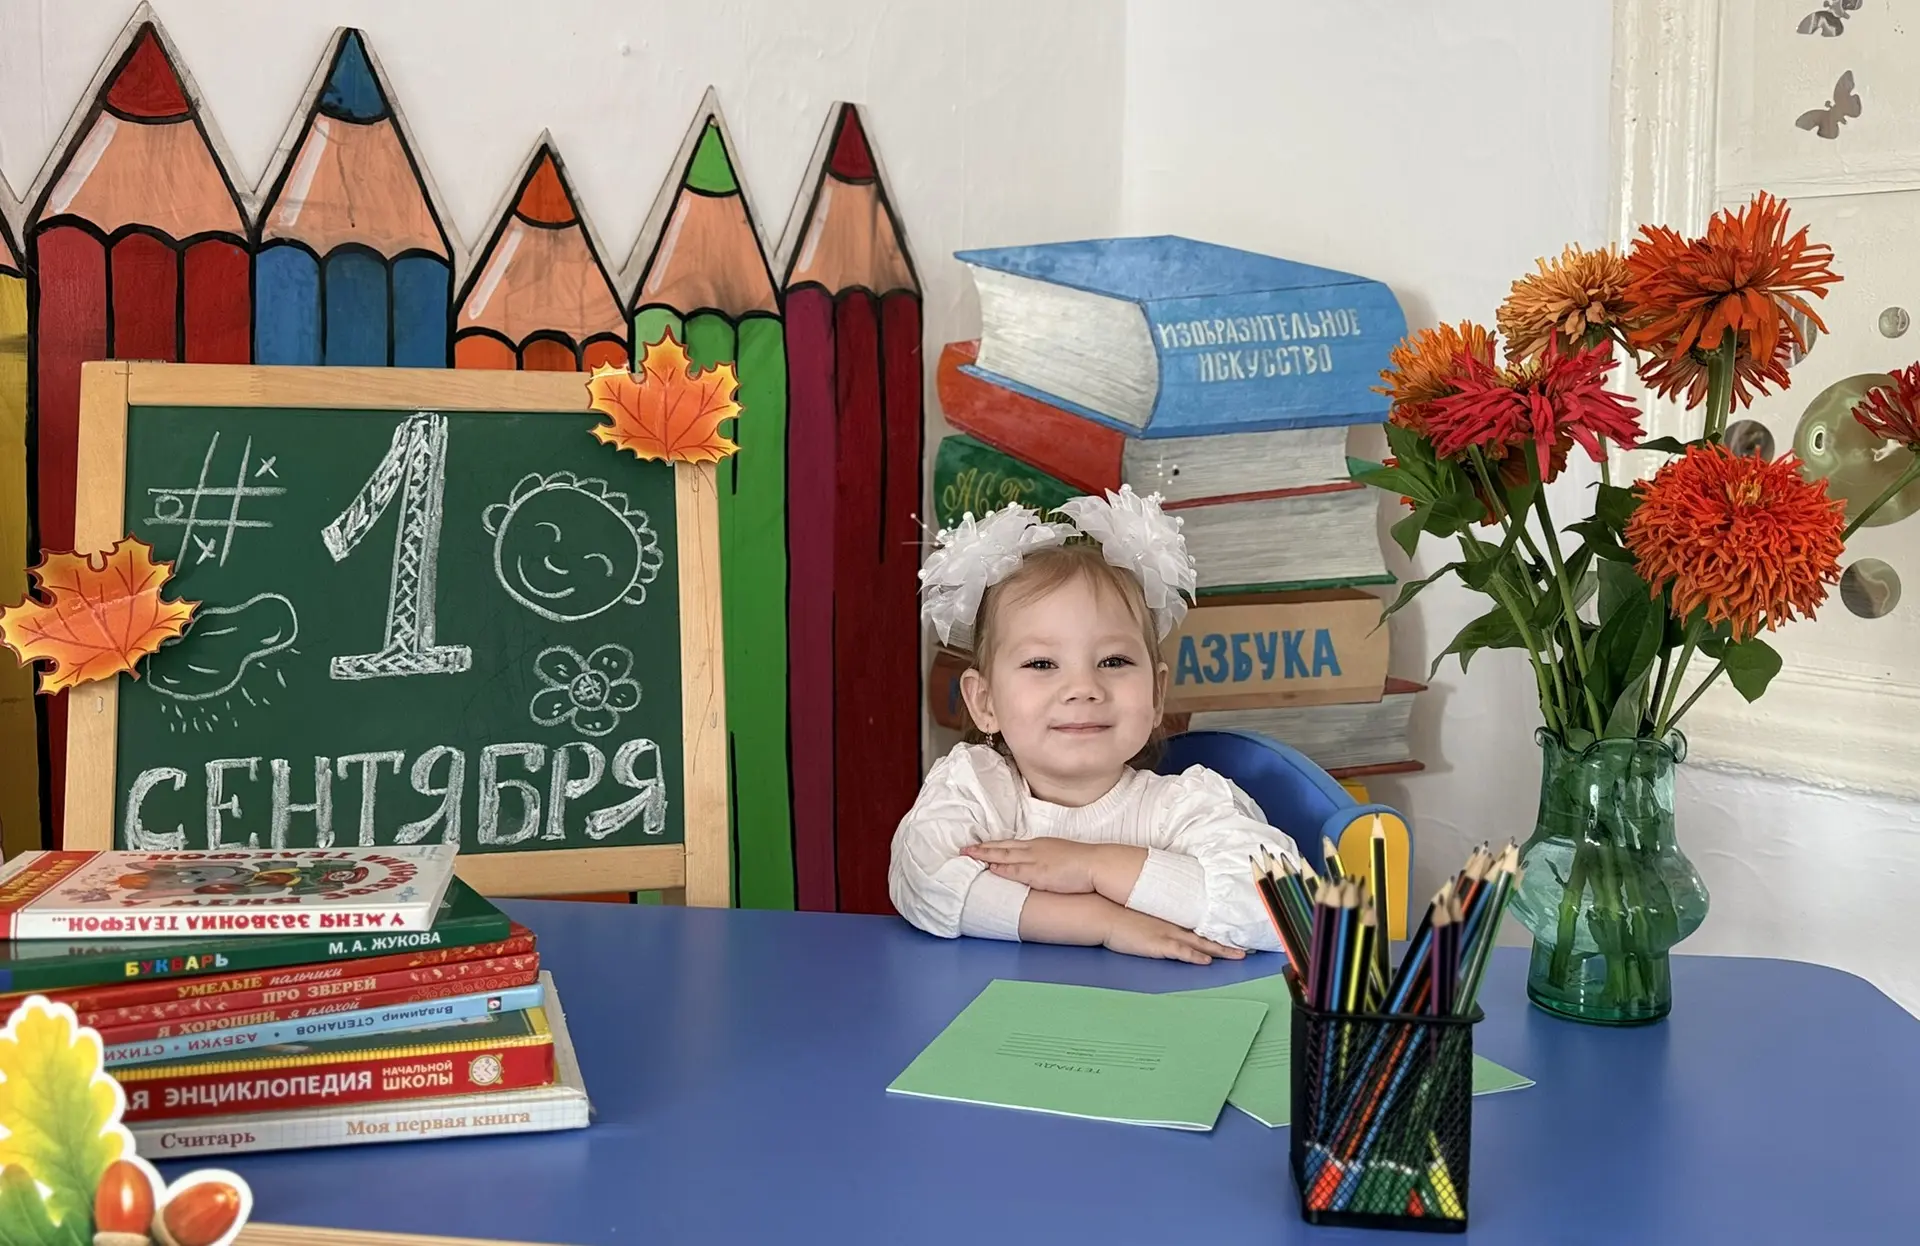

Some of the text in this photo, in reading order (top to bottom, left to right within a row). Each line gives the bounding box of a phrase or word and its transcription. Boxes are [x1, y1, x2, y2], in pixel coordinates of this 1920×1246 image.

[1156, 308, 1361, 349] ИЗОБРАЗИТЕЛЬНОЕ
[1198, 343, 1333, 383] ИСКУССТВО
[322, 412, 472, 680] 1
[1175, 628, 1342, 686] АЗБУКА
[124, 738, 668, 850] СЕНТЯБРЯ
[320, 913, 385, 928] МЕНЯ
[390, 913, 405, 926] У
[329, 943, 347, 955] М.
[371, 932, 441, 950] ЖУКОВА
[125, 954, 229, 977] БУКВАРЬ
[177, 967, 342, 998] УМЕЛЫЕ пальчики
[262, 977, 377, 1004] ПРО ЗВЕРЕЙ
[382, 1005, 454, 1021] Владимир
[157, 1026, 171, 1038] Я
[296, 1016, 374, 1036] СТЕПАНОВ
[188, 1032, 257, 1051] АЗБУКИ
[382, 1060, 453, 1076] НАЧАЛЬНОЙ
[164, 1070, 372, 1108] ЭНЦИКЛОПЕДИЯ
[382, 1072, 453, 1091] ШКОЛЫ
[346, 1110, 530, 1136] Моя первая книга
[160, 1132, 256, 1149] Считарь
